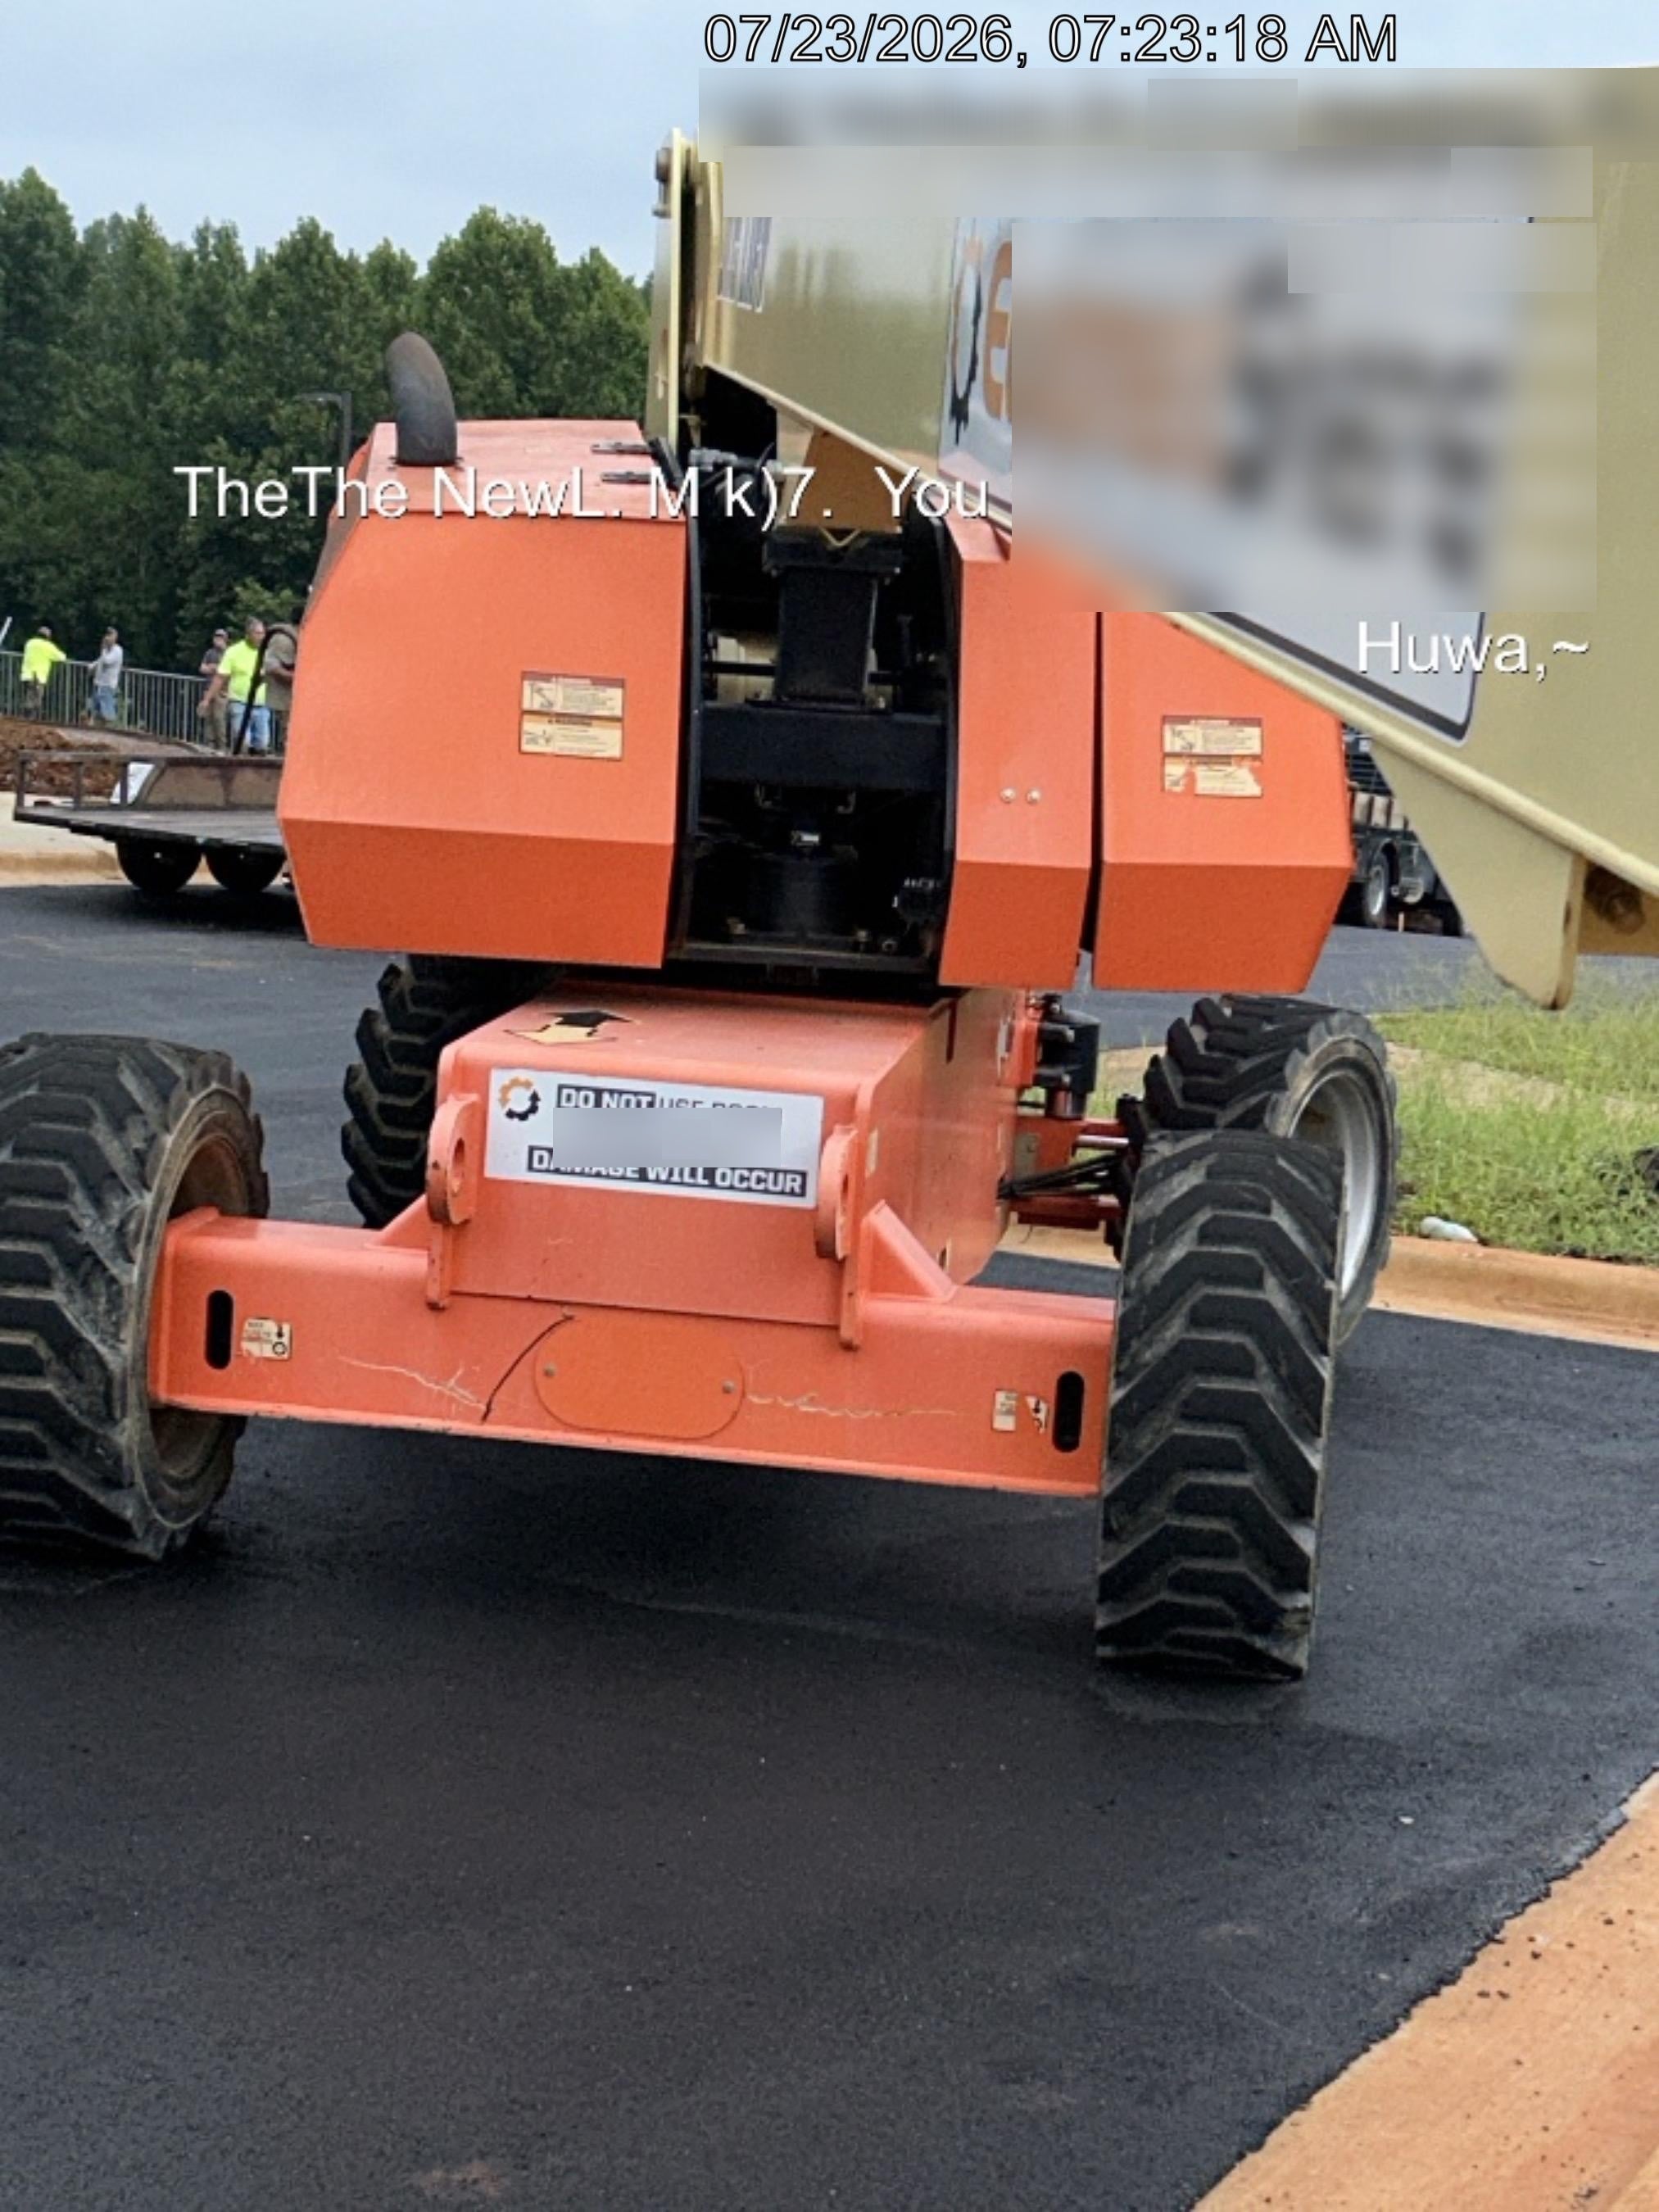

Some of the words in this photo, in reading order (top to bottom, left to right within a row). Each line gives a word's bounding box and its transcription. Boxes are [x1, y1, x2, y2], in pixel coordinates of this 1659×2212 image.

[560, 1088, 595, 1108] DO
[601, 1091, 652, 1108] NOT
[646, 1167, 709, 1185] WILL
[714, 1167, 803, 1193] OCCUR
